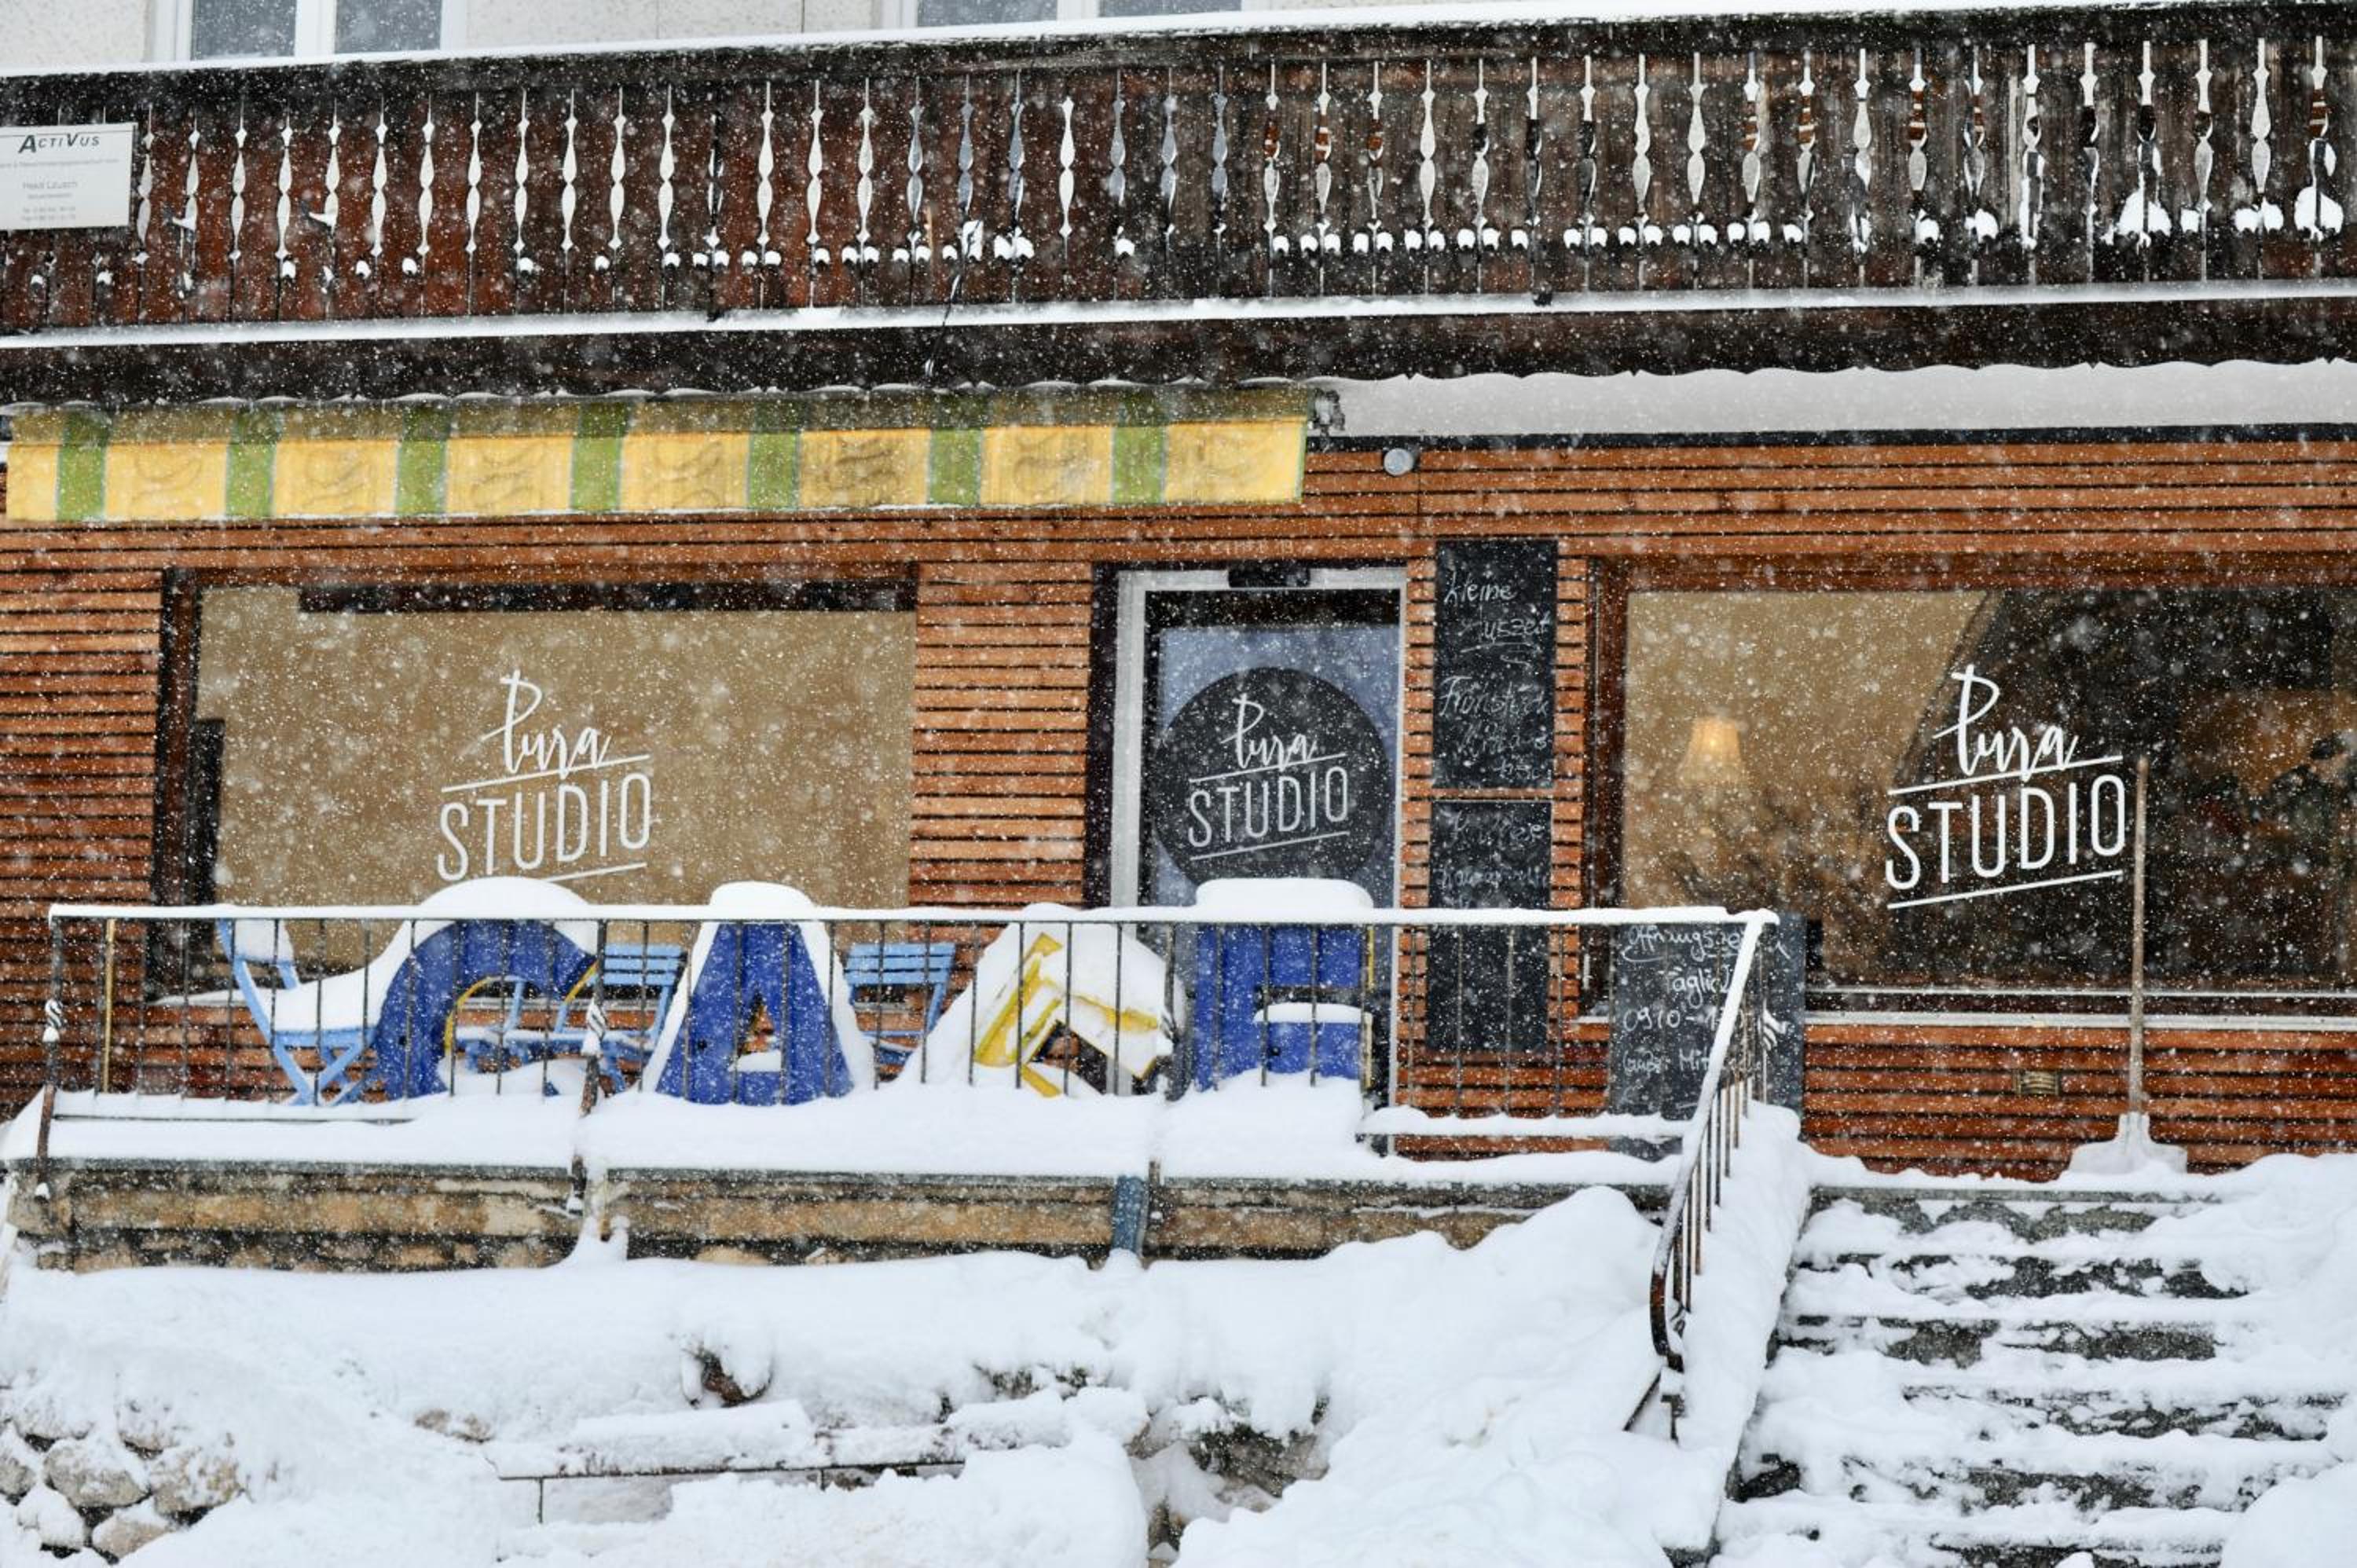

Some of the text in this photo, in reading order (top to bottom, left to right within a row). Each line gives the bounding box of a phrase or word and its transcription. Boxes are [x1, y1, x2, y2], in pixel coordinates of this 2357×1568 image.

[480, 669, 612, 780] Pura
[1219, 692, 1318, 772] Pura
[1932, 664, 2079, 782] Pura
[437, 772, 651, 882] STUDIO
[1187, 766, 1348, 848] STUDIO
[1886, 774, 2125, 891] STUDIO
